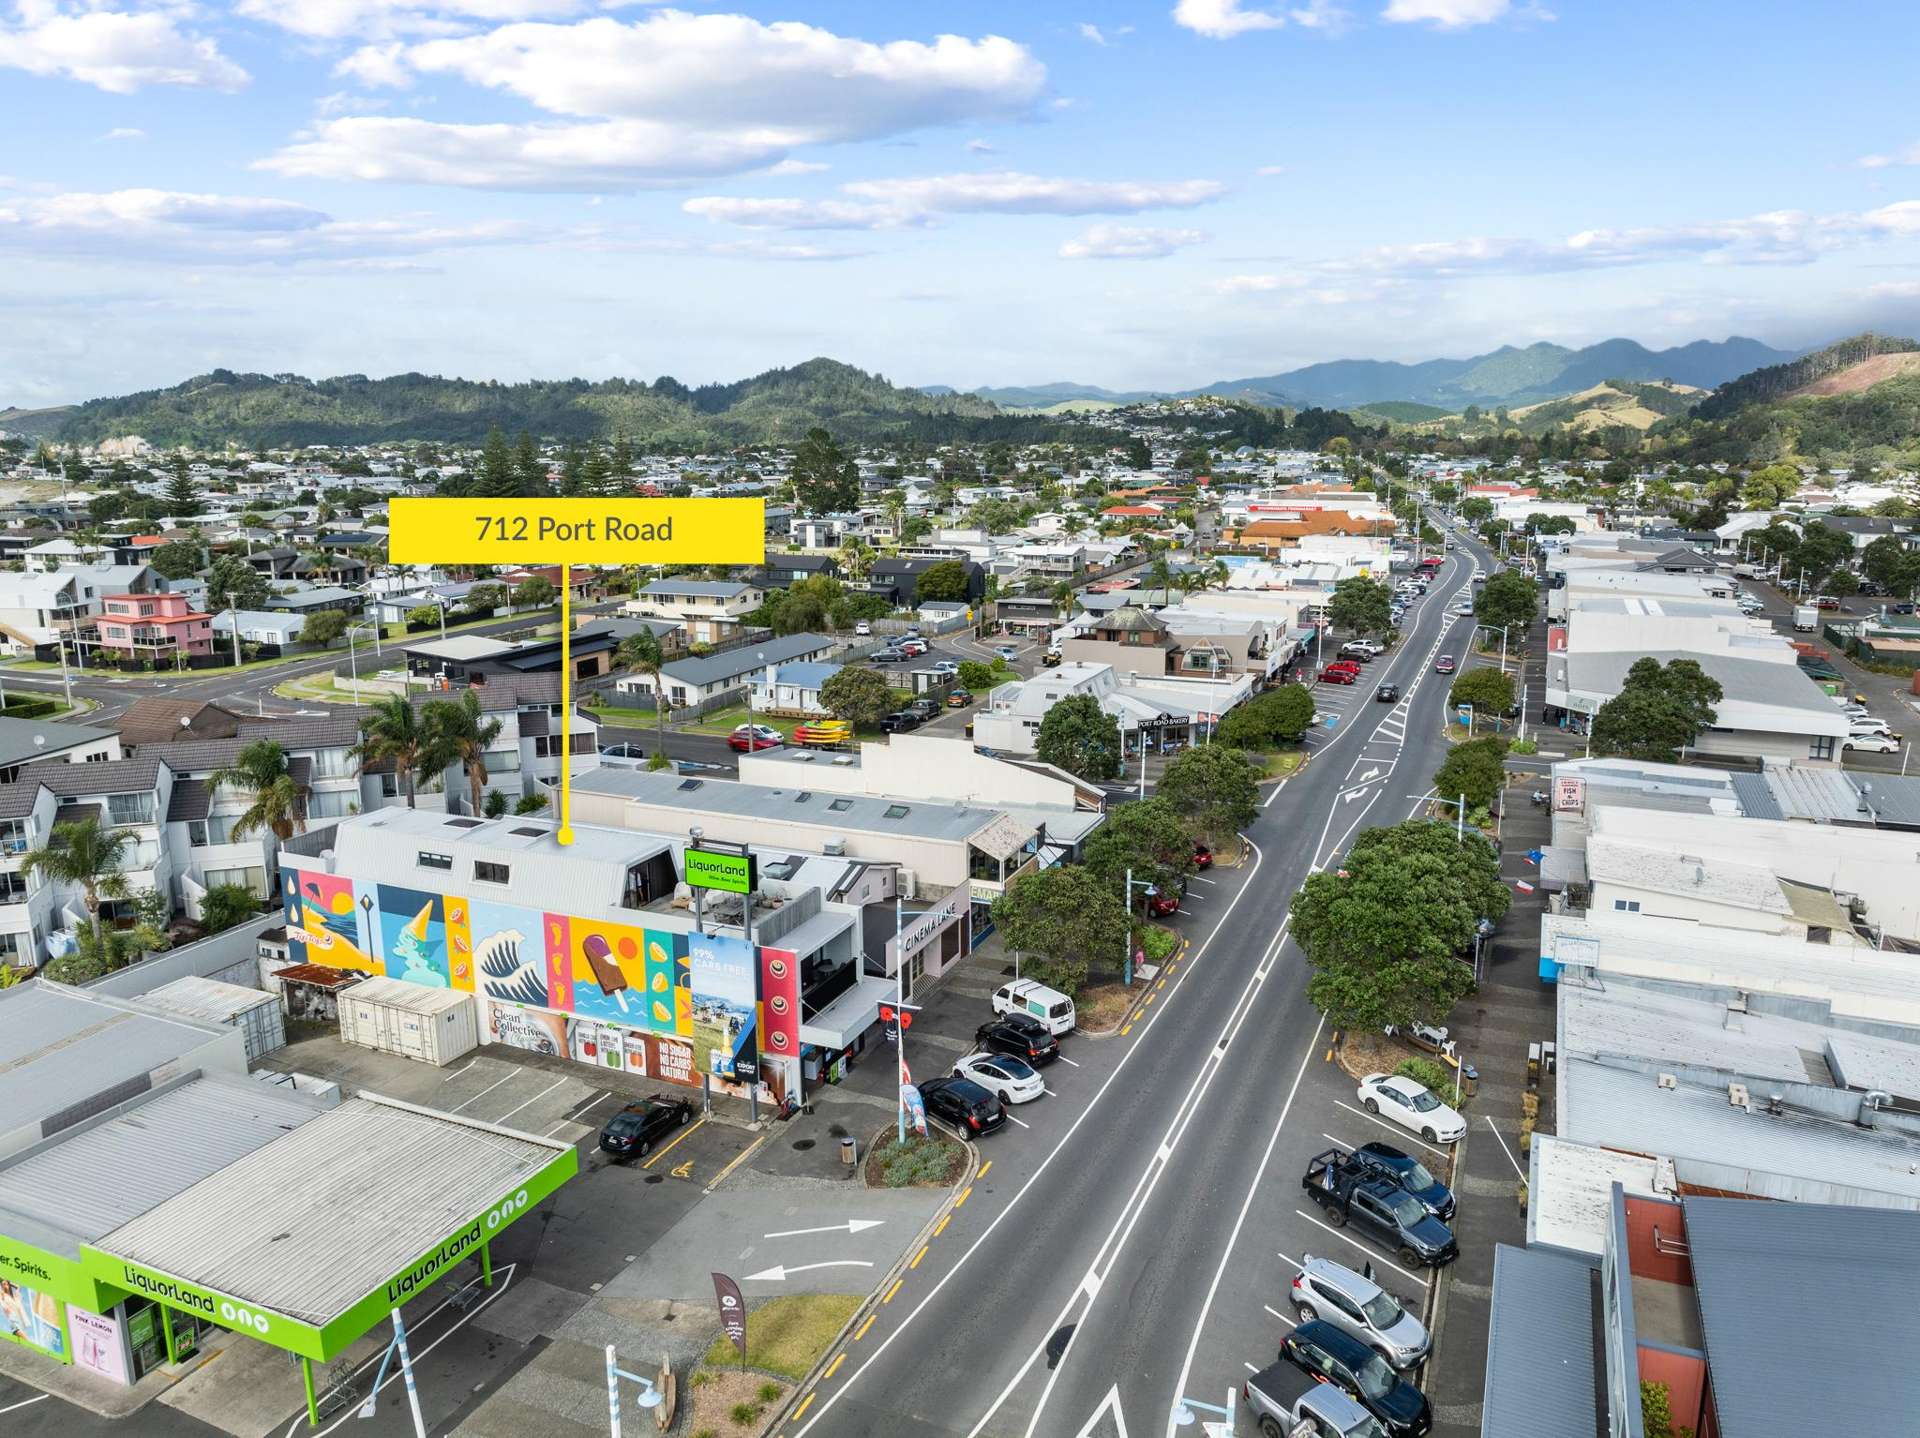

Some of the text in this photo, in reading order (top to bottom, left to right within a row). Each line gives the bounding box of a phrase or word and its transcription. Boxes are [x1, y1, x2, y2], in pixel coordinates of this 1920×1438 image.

[688, 859, 746, 877] LiquorLand
[904, 901, 956, 952] CINEMA LANE
[493, 1007, 521, 1024] Clean
[494, 1019, 543, 1037] Collective
[659, 1041, 669, 1054] NO
[669, 1043, 691, 1060] SUGAR
[659, 1053, 692, 1071] NO CARBS
[14, 1256, 52, 1281] Spirits.
[388, 1222, 482, 1303] LiquorLand
[124, 1265, 216, 1314] LiquorLand
[90, 1320, 113, 1334] LEMON
